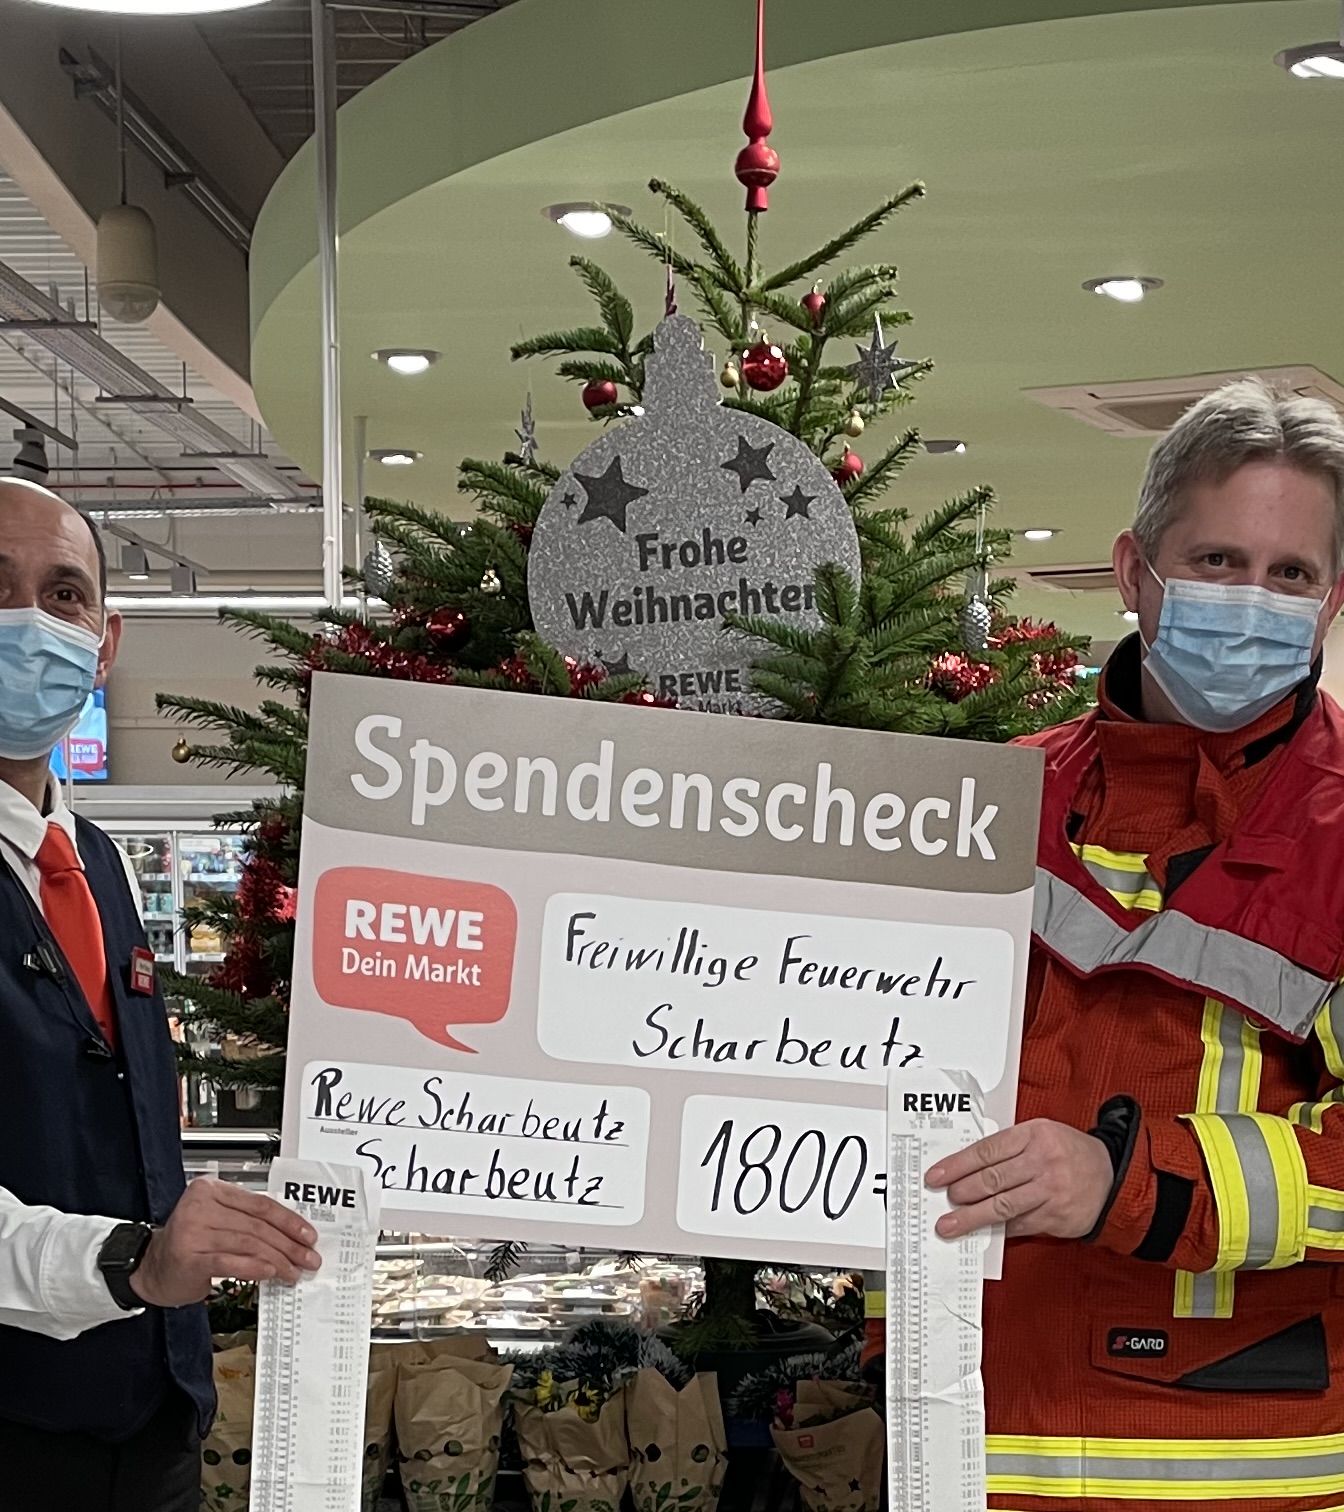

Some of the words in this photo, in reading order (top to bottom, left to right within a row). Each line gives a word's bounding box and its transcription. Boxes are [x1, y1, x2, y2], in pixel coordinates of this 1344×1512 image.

[635, 527, 748, 571] Frohe
[659, 669, 742, 697] REWE
[350, 714, 1000, 862] Spendenscheck
[343, 898, 485, 951] REWE
[342, 947, 397, 981] Dein
[404, 953, 482, 988] Markt
[566, 911, 759, 989] Freiwillige
[779, 933, 977, 1001] Feuerwehr
[632, 1003, 925, 1070] Scharbeutz
[311, 1067, 406, 1126] Rewe
[418, 1077, 629, 1141] Scharbeutz
[903, 1093, 971, 1112] REWE
[284, 1181, 356, 1209] REWE
[356, 1138, 604, 1206] Scharbeutz
